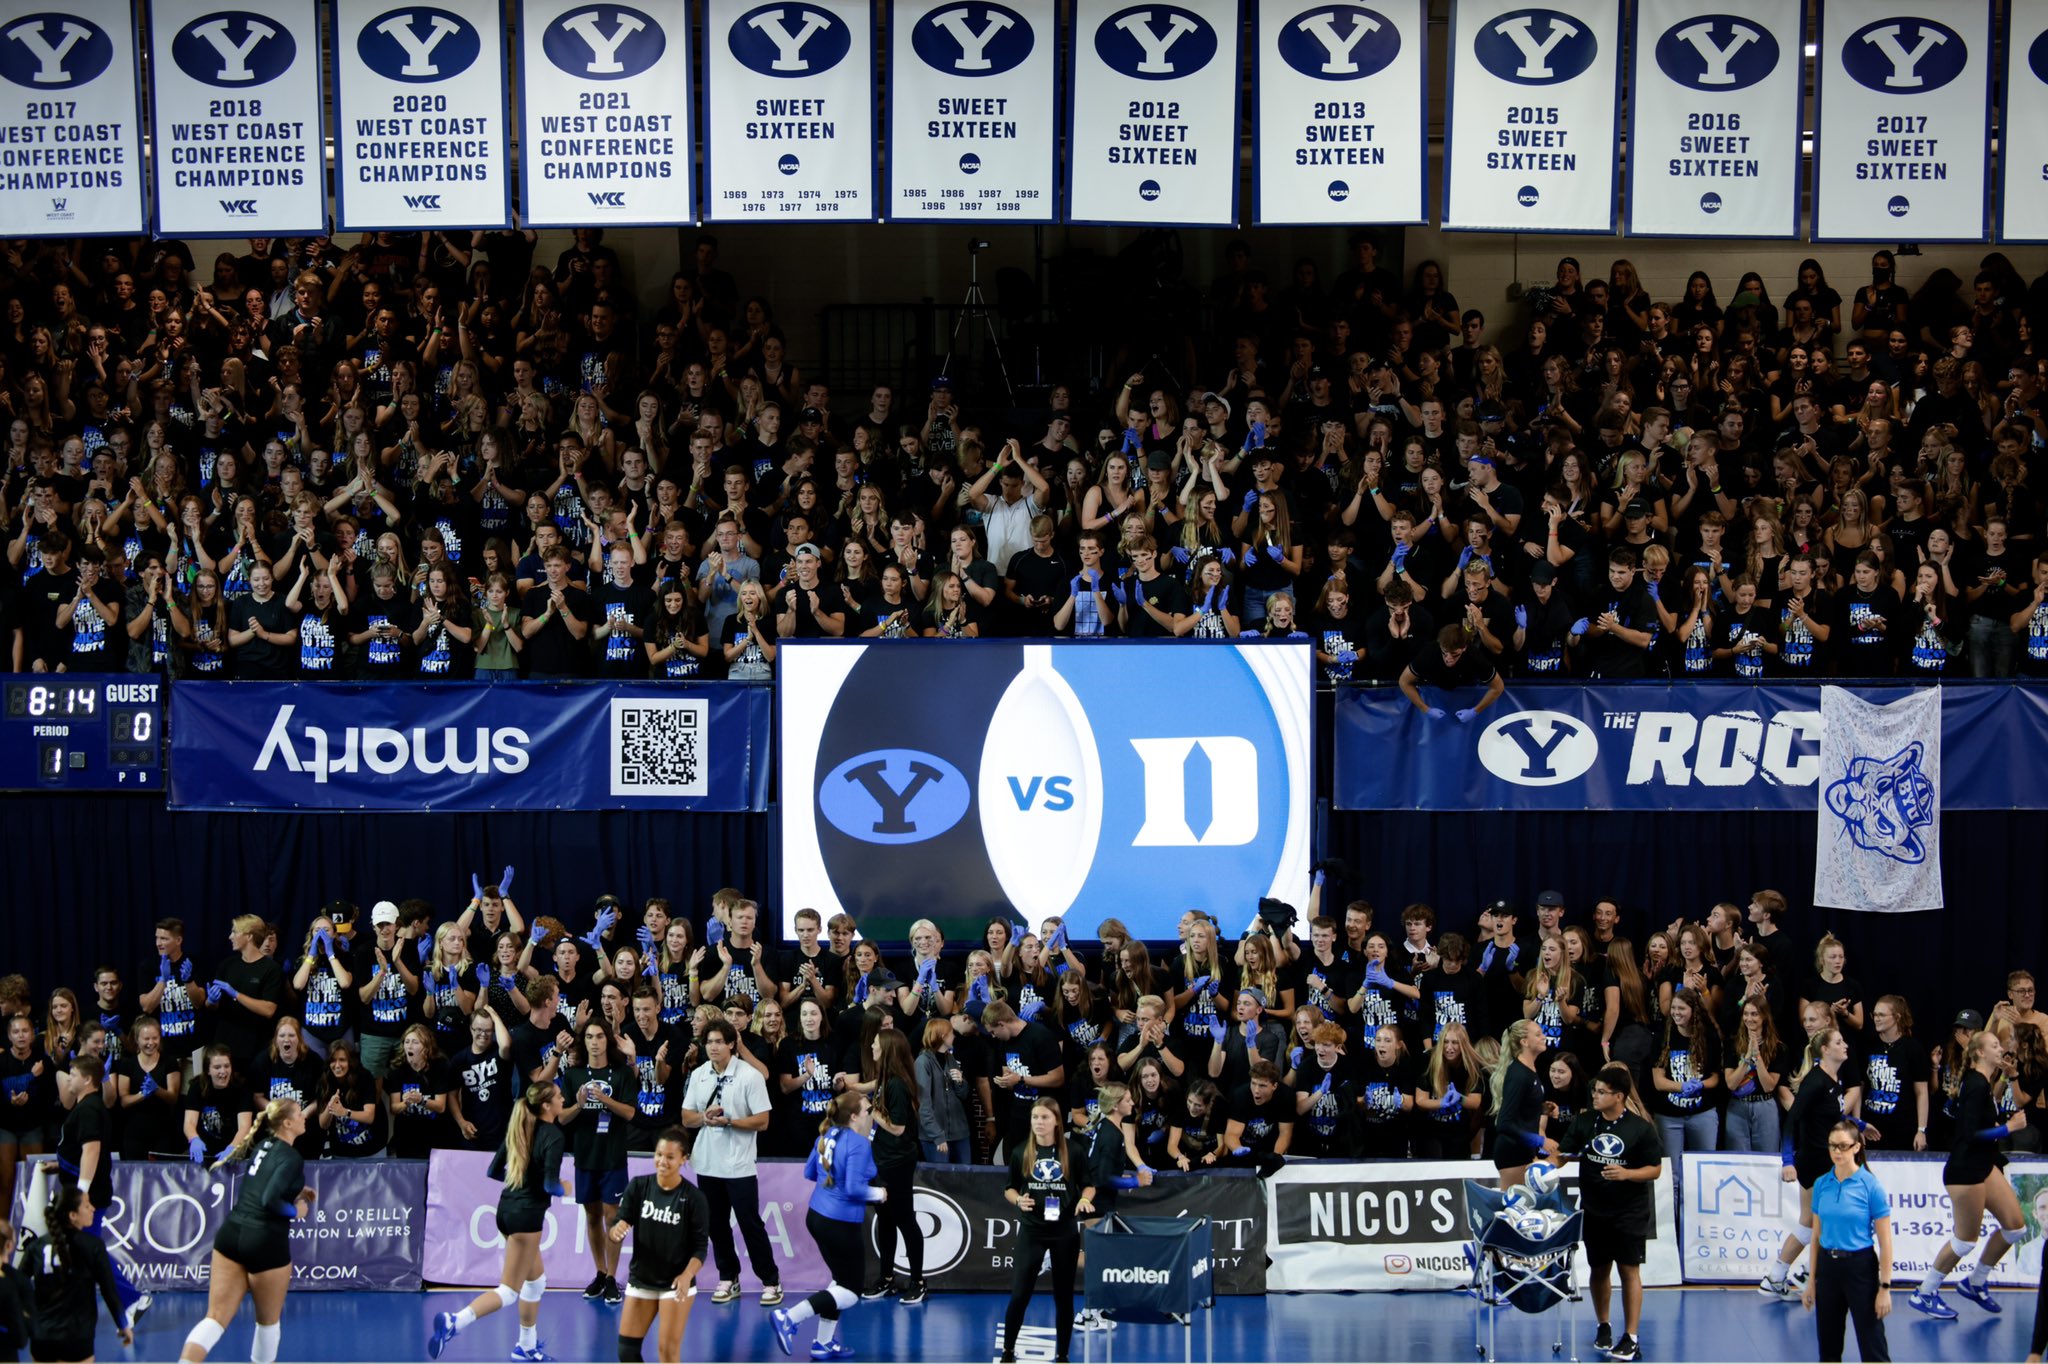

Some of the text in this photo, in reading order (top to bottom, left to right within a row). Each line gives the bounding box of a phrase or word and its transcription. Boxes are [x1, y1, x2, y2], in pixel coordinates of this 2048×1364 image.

[377, 15, 460, 76] Y
[562, 12, 646, 73] Y
[748, 9, 831, 70] Y
[932, 8, 1015, 69] Y
[1115, 12, 1198, 73] Y
[1297, 12, 1381, 73] Y
[6, 20, 92, 82] Y
[191, 18, 277, 80] Y
[1494, 17, 1578, 78] Y
[1676, 22, 1760, 84] Y
[1862, 24, 1948, 87] Y
[210, 100, 261, 117] 2018
[394, 95, 446, 112] 2020
[580, 93, 630, 109] 2021
[757, 100, 825, 116] SWEET
[939, 98, 1007, 115] SWEET
[27, 102, 76, 119] 2017
[1129, 102, 1179, 119] 2012
[1315, 102, 1365, 119] 2013
[1508, 107, 1558, 124] 2015
[357, 118, 486, 136] WEST COAST
[542, 115, 671, 133] WEST COAST
[928, 121, 1015, 138] SIXTEEN
[1689, 113, 1740, 130] 2016
[1877, 117, 1927, 133] 2017
[55, 124, 121, 142] COAST
[172, 123, 303, 140] WEST COAST
[747, 123, 834, 139] SIXTEEN
[1120, 124, 1188, 142] SWEET
[1306, 125, 1374, 142] SWEET
[1499, 130, 1567, 147] SWEET
[356, 141, 488, 159] CONFERENCE
[541, 138, 673, 156] CONFERENCE
[1681, 136, 1749, 153] SWEET
[1868, 140, 1937, 156] SWEET
[172, 146, 305, 164] CONFERENCE
[1109, 147, 1196, 165] SIXTEEN
[1296, 148, 1384, 165] SIXTEEN
[1487, 153, 1575, 170] SIXTEEN
[360, 164, 486, 182] CHAMPIONS
[545, 161, 671, 179] CHAMPIONS
[1670, 159, 1758, 176] SIXTEEN
[1856, 163, 1946, 179] SIXTEEN
[176, 169, 303, 187] CHAMPIONS
[404, 195, 440, 208] WCC
[588, 192, 625, 205] WCC
[904, 189, 926, 197] 1985
[1016, 190, 1038, 198] 1992
[220, 200, 257, 213] WCC
[816, 203, 838, 211] 1978
[923, 202, 945, 210] 1996
[301, 657, 334, 669] PARTY
[421, 659, 451, 673] PARTY
[29, 686, 95, 713] 8:14
[106, 684, 159, 703] GUEST
[33, 725, 69, 737] PERIOD
[134, 712, 151, 742] 0
[253, 704, 530, 783] smarty
[1602, 710, 1821, 787] THE ROC
[118, 772, 147, 783] P B
[1006, 776, 1074, 811] VS
[1129, 736, 1259, 846] D
[305, 1013, 341, 1027] PARTY
[372, 1007, 407, 1023] PARTY
[1377, 1011, 1398, 1025] THE
[161, 1020, 195, 1036] PARTY
[1598, 1136, 1620, 1154] Y
[249, 1149, 267, 1177] 5
[335, 1207, 413, 1223] O'REILLY
[641, 1199, 681, 1226] Duke
[1309, 1187, 1455, 1237] NICO'S
[348, 1225, 411, 1239] LAWYERS
[1698, 1225, 1783, 1242] LEGACY
[1102, 1266, 1170, 1285] molten
[1738, 1265, 1769, 1274] ESTA
